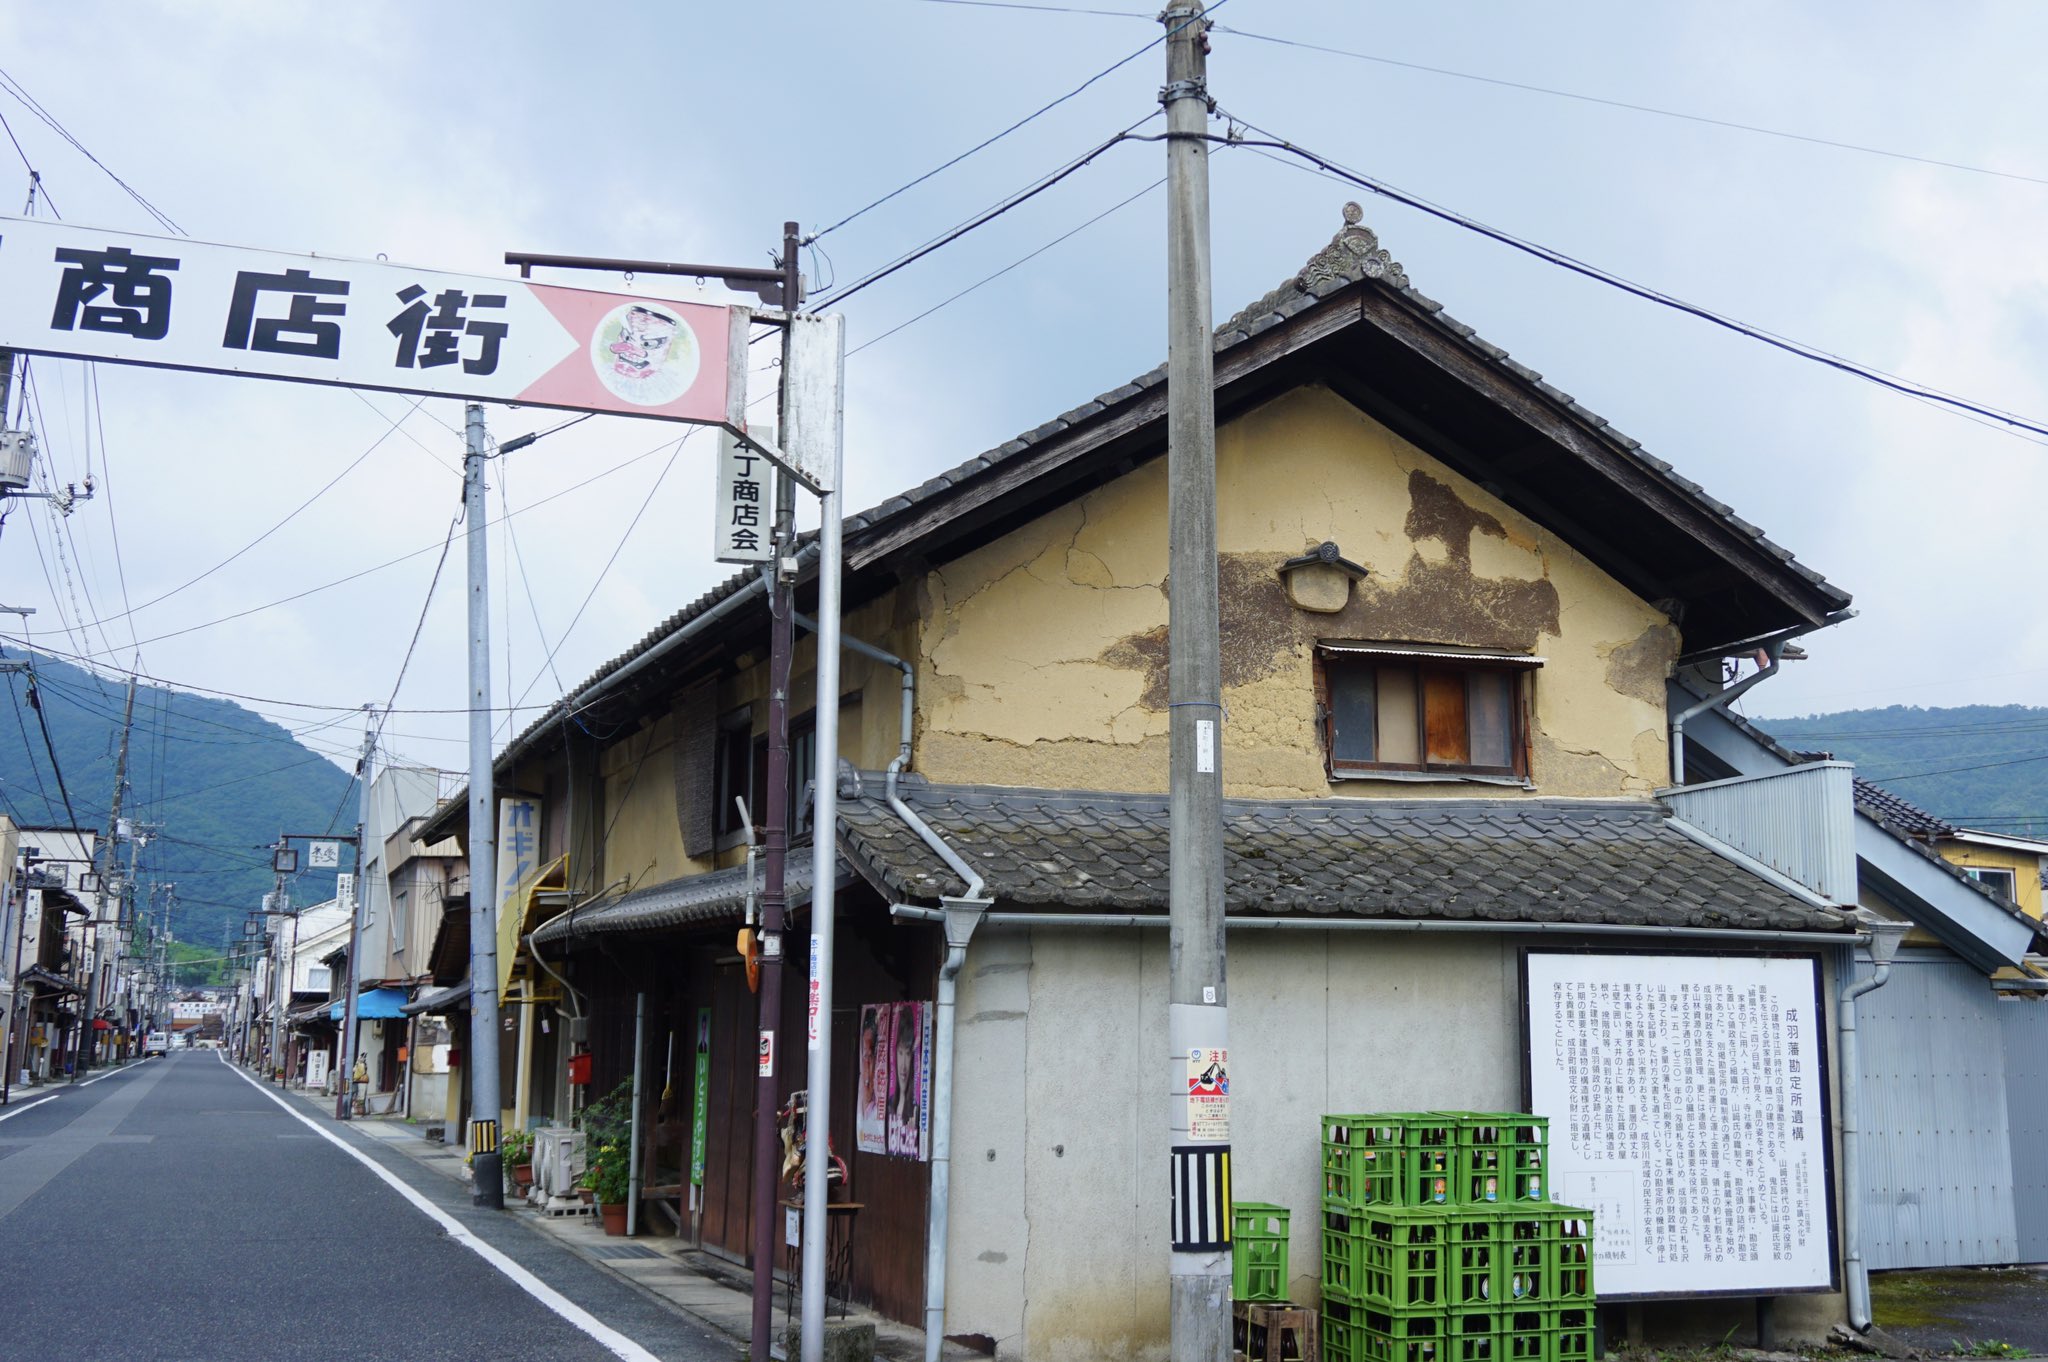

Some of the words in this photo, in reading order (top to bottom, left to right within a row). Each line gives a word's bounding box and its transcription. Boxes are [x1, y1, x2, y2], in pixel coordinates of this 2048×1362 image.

[0, 234, 509, 377] 商店街
[504, 802, 534, 899] オギノ
[1553, 982, 1564, 1070] 保存することにした。
[1786, 1008, 1804, 1141] 成羽藩勘定所遺構
